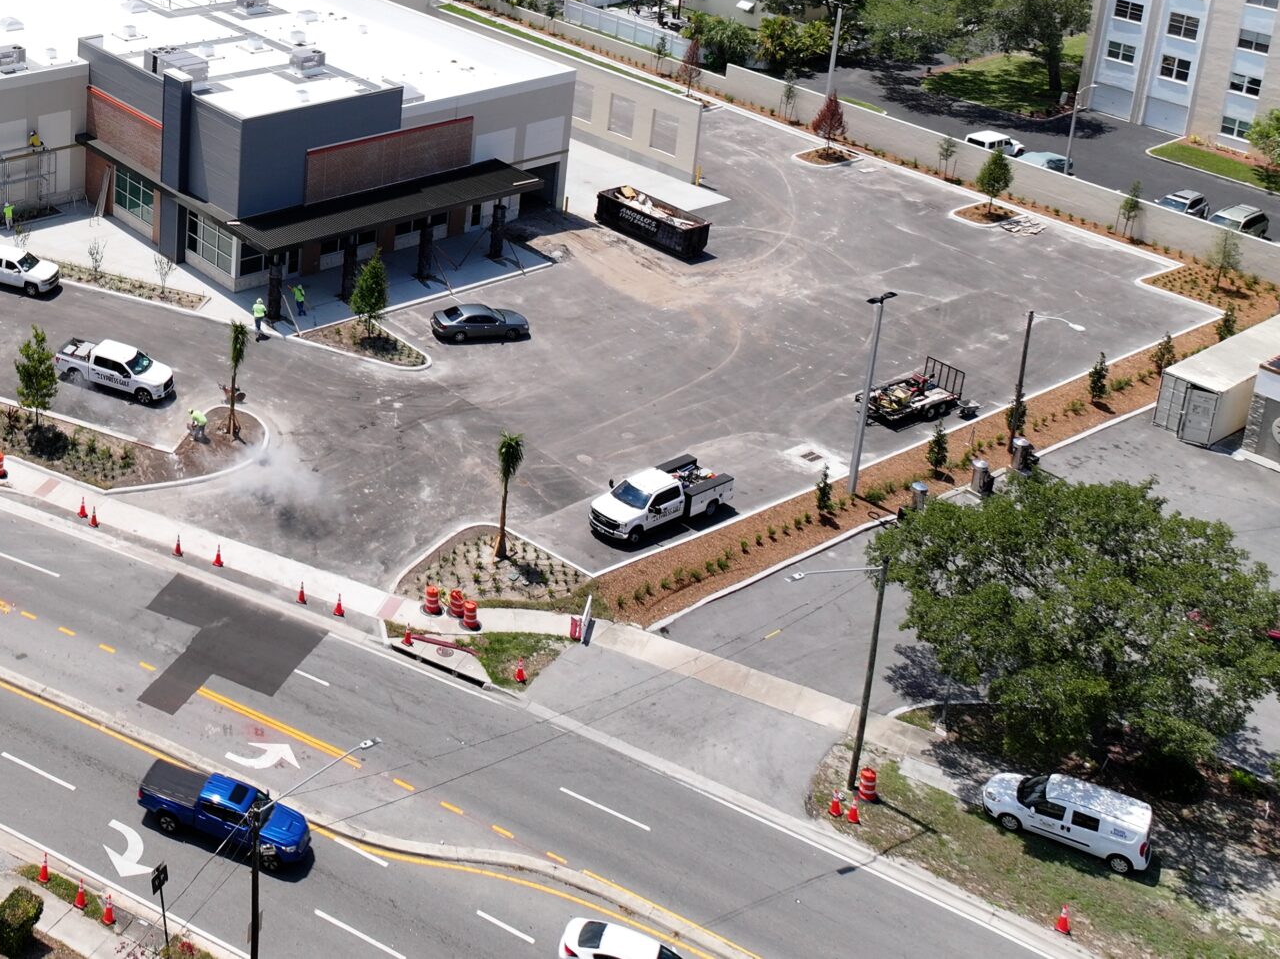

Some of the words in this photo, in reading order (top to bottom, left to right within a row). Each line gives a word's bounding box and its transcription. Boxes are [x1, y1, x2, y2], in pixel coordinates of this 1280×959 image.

[620, 207, 657, 227] ANGELO'S
[100, 374, 120, 385] CYPRESS
[119, 379, 130, 387] GULF
